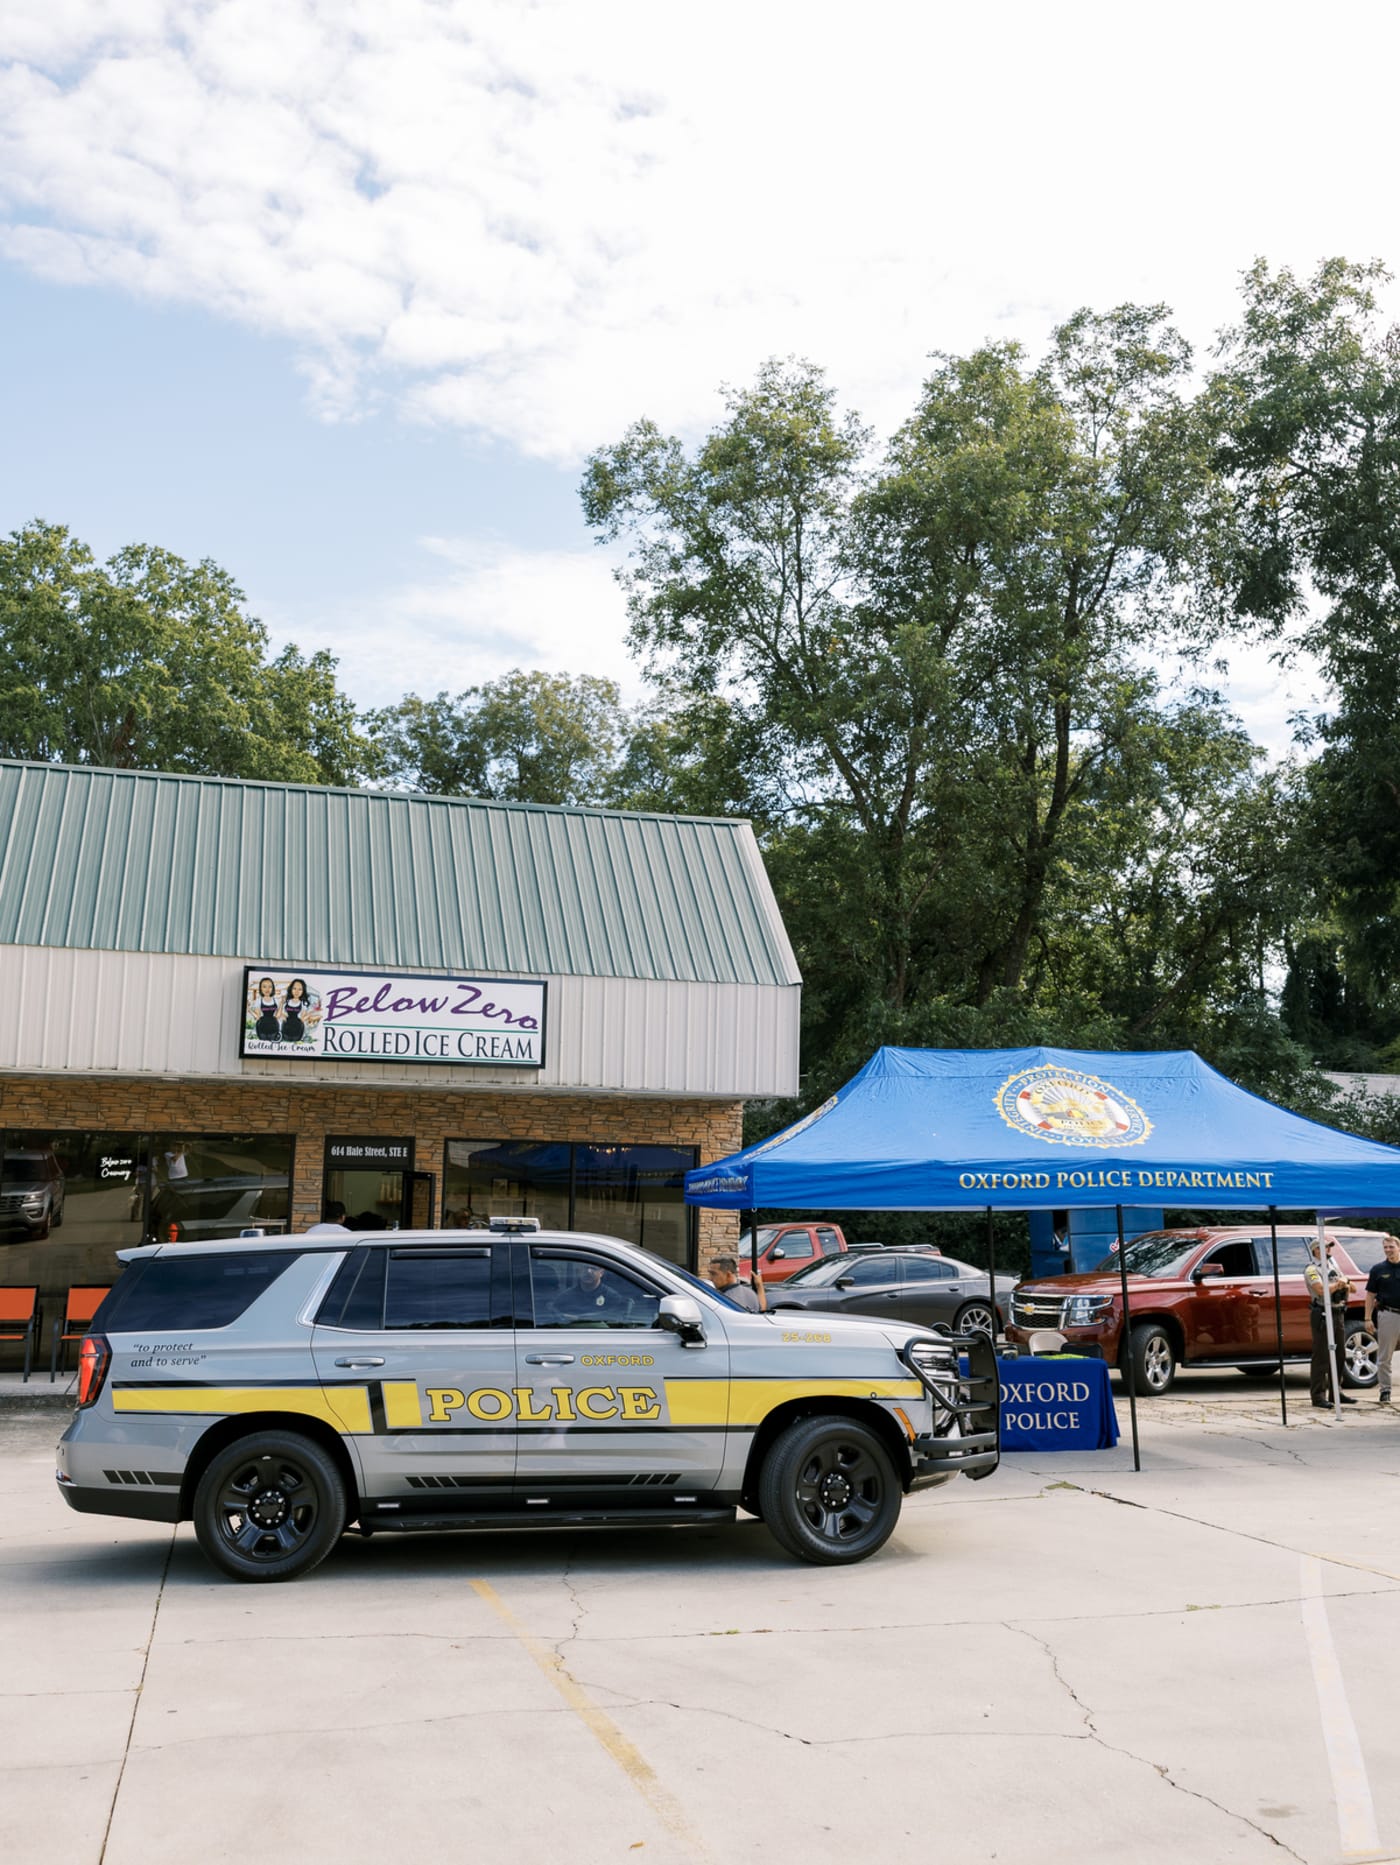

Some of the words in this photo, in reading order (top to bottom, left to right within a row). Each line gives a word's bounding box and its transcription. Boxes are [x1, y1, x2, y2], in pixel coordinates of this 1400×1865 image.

[324, 983, 449, 1022] Below
[450, 984, 538, 1029] Zero
[323, 1027, 410, 1055] ROLLED
[415, 1030, 449, 1056] ICE
[457, 1032, 533, 1059] CREAM
[331, 1146, 345, 1156] 614
[346, 1146, 363, 1156] Hale
[389, 1147, 401, 1157] STE
[402, 1147, 408, 1157] E
[959, 1172, 1050, 1189] OXFORD
[1056, 1170, 1132, 1188] POLICE
[1138, 1171, 1274, 1189] DEPARTMENT
[152, 1342, 193, 1354] protect
[130, 1357, 153, 1367] and
[156, 1358, 168, 1366] to
[580, 1355, 655, 1366] OXFORD
[425, 1385, 662, 1422] POLICE
[1005, 1412, 1080, 1430] POLICE
